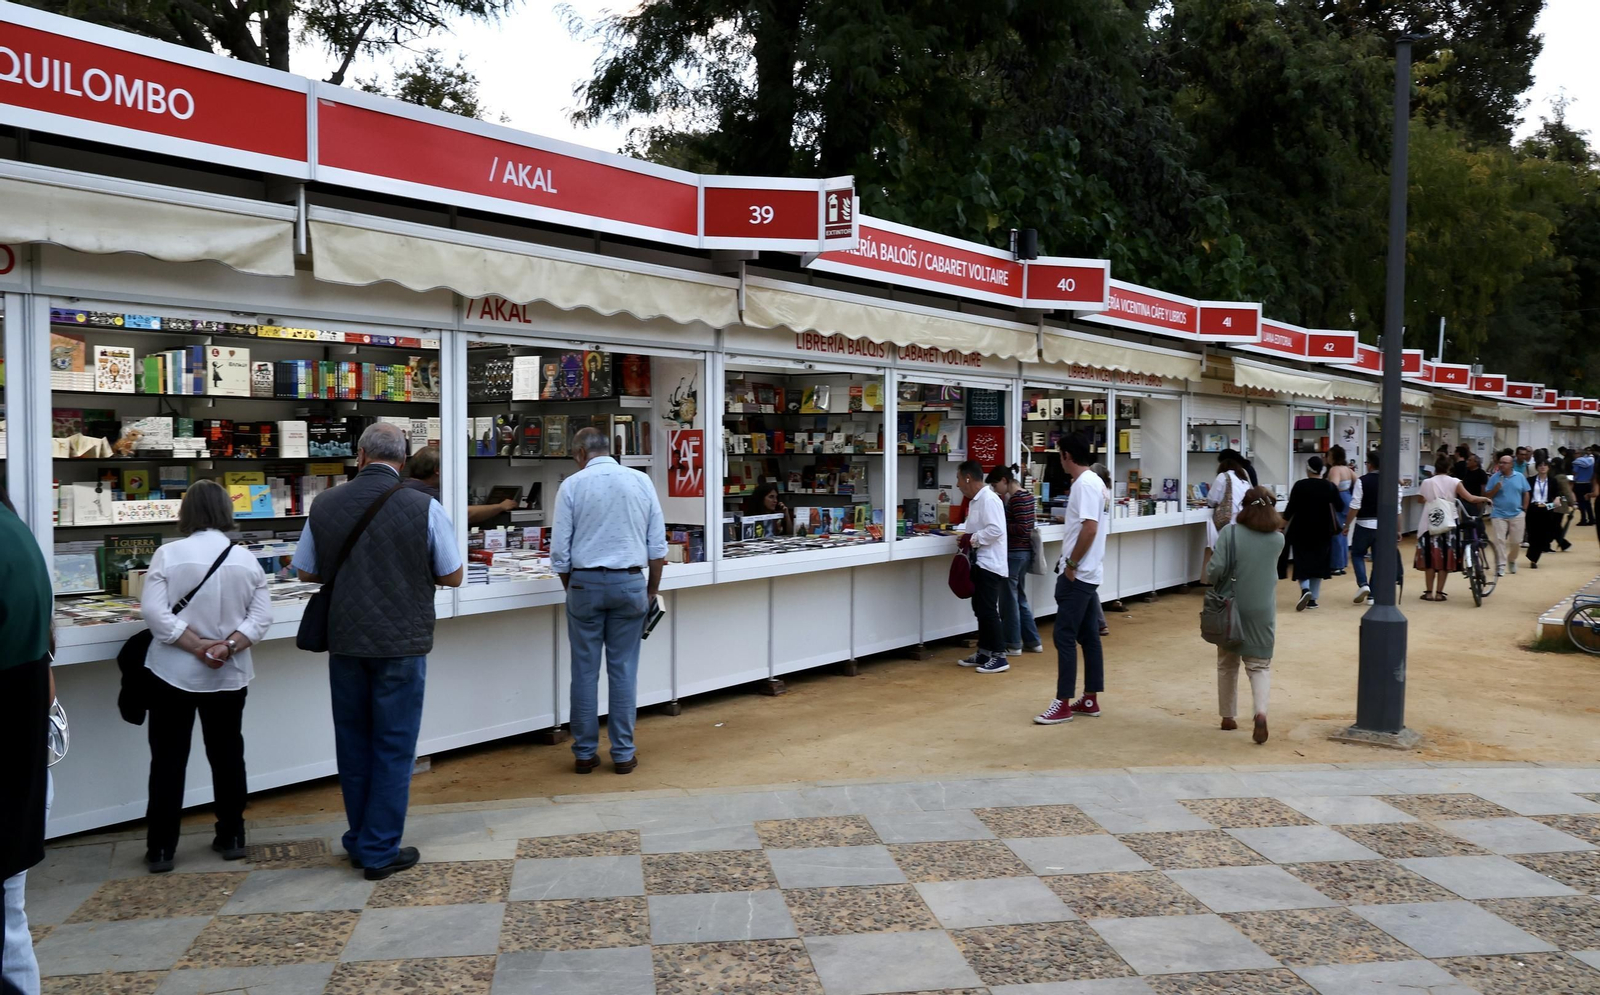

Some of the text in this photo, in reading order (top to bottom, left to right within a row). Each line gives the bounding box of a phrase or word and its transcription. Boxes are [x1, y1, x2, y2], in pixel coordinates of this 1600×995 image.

[0, 46, 195, 120] QUILOMBO
[502, 160, 558, 194] AKAL
[748, 205, 775, 225] 39
[880, 242, 917, 267] BALQÍS
[925, 253, 967, 277] CABARET
[968, 262, 1009, 286] VOLTAIRE
[1057, 278, 1076, 292] 40
[480, 297, 532, 323] AKAL
[1222, 316, 1232, 327] 41
[1323, 342, 1335, 352] 42
[115, 547, 154, 555] MUNDIAL
[120, 539, 155, 547] GUERRA
